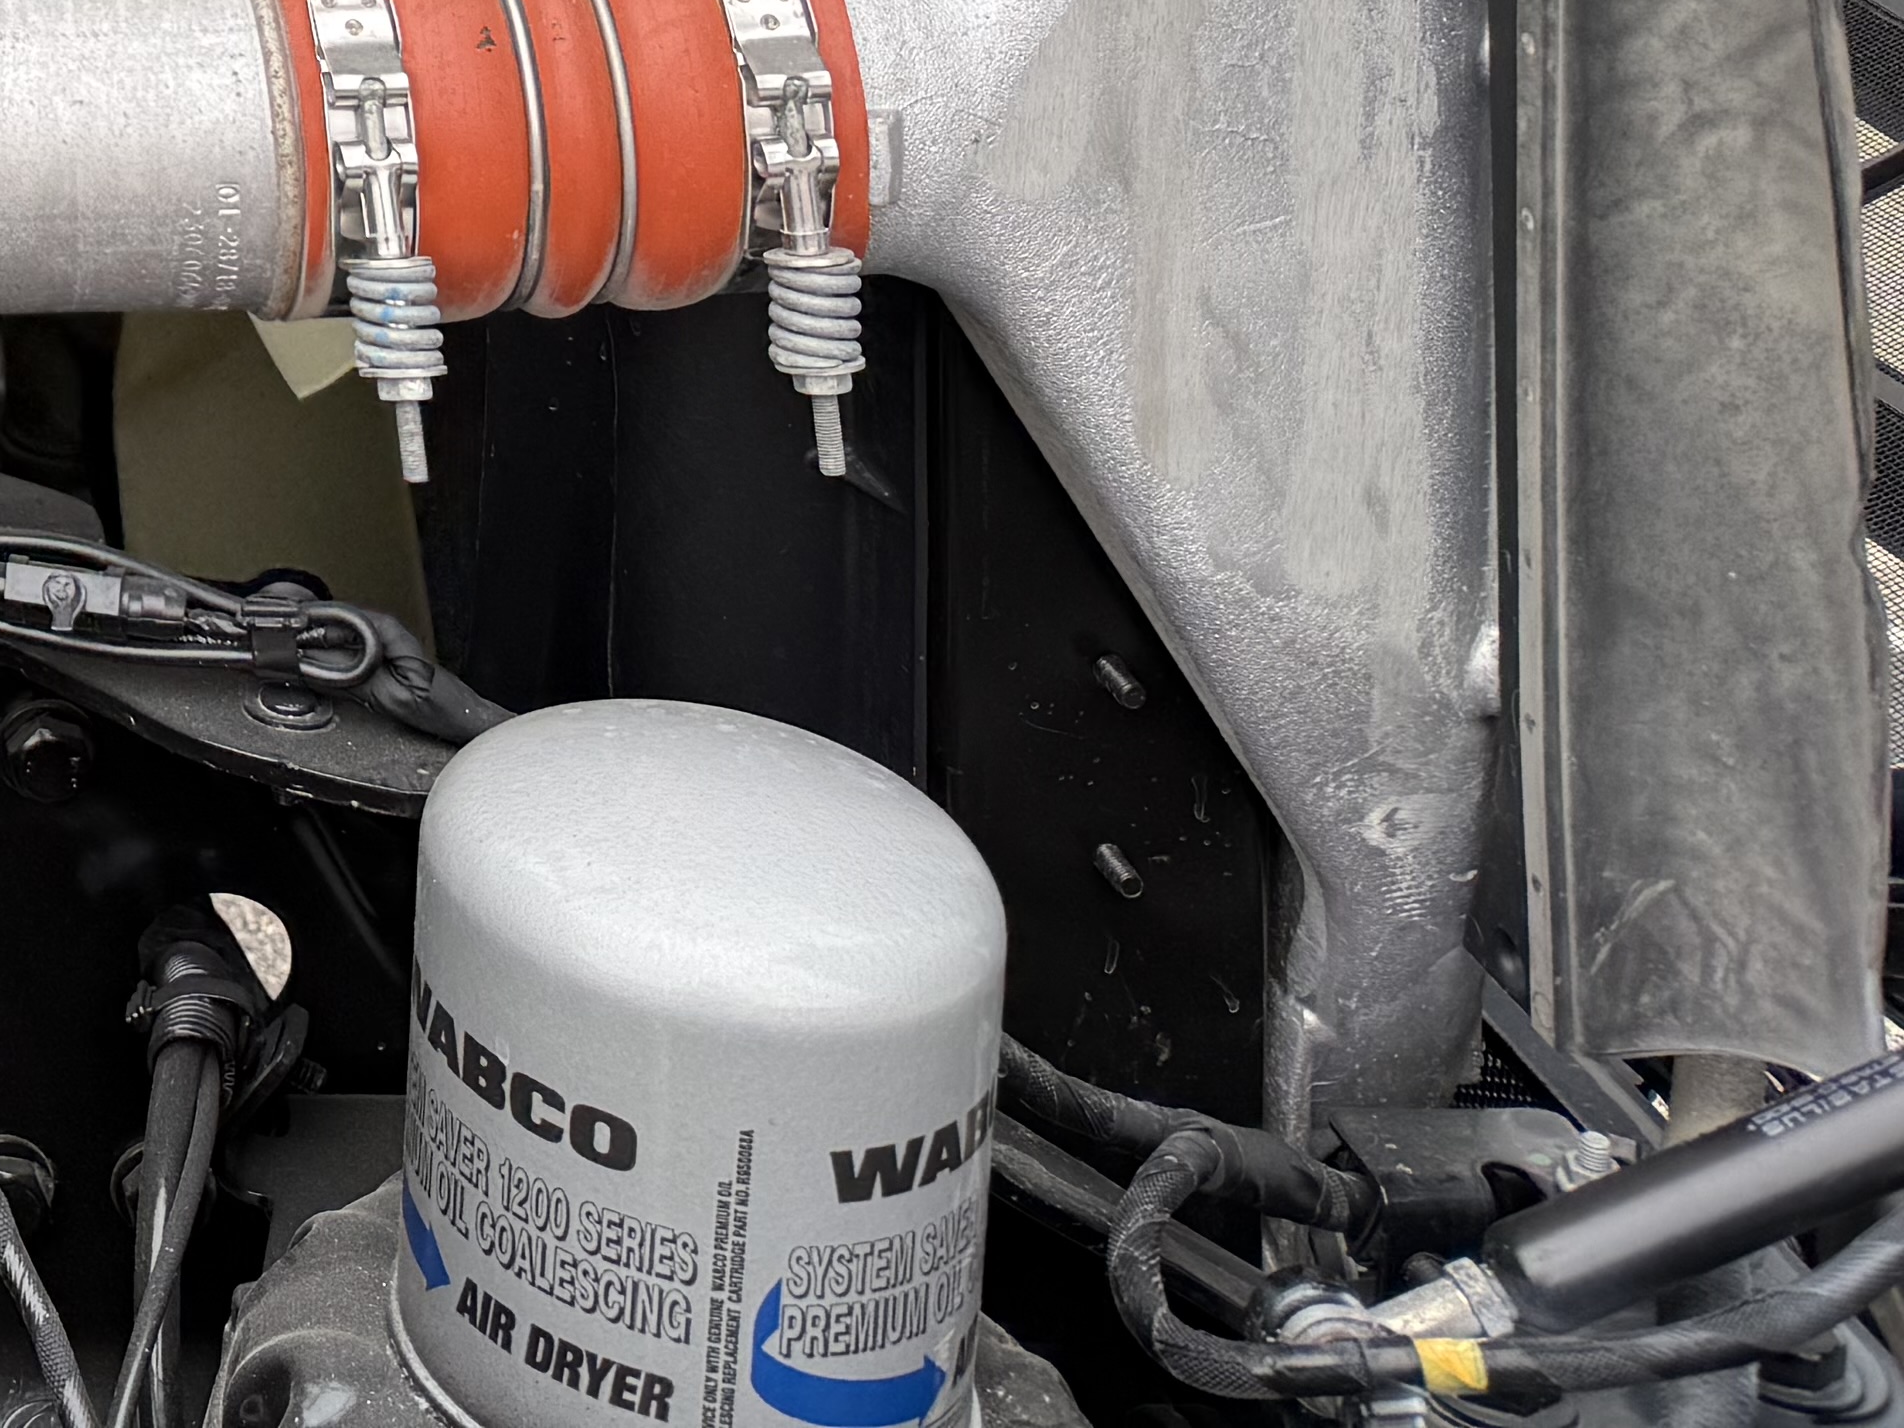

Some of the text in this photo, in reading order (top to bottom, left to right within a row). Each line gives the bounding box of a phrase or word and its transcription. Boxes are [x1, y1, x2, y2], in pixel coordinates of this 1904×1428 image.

[428, 1088, 490, 1196] SAVER
[499, 1157, 569, 1242] 1200
[578, 1200, 698, 1286] SERIES
[436, 1160, 692, 1344] OIL COALESCING
[713, 1199, 731, 1250] PREMIUM
[732, 1208, 748, 1237] PART
[711, 1253, 727, 1291] WABCO
[728, 1240, 746, 1303] CARTRIDGE
[786, 1230, 915, 1301] SYSTEM
[456, 1275, 675, 1423] AIR DRYER
[707, 1298, 724, 1343] GENUINE
[722, 1308, 741, 1384] REPLACEMENT
[779, 1282, 929, 1358] PREMIUM
[703, 1376, 718, 1402] ONLY
[705, 1346, 720, 1373] WITH
